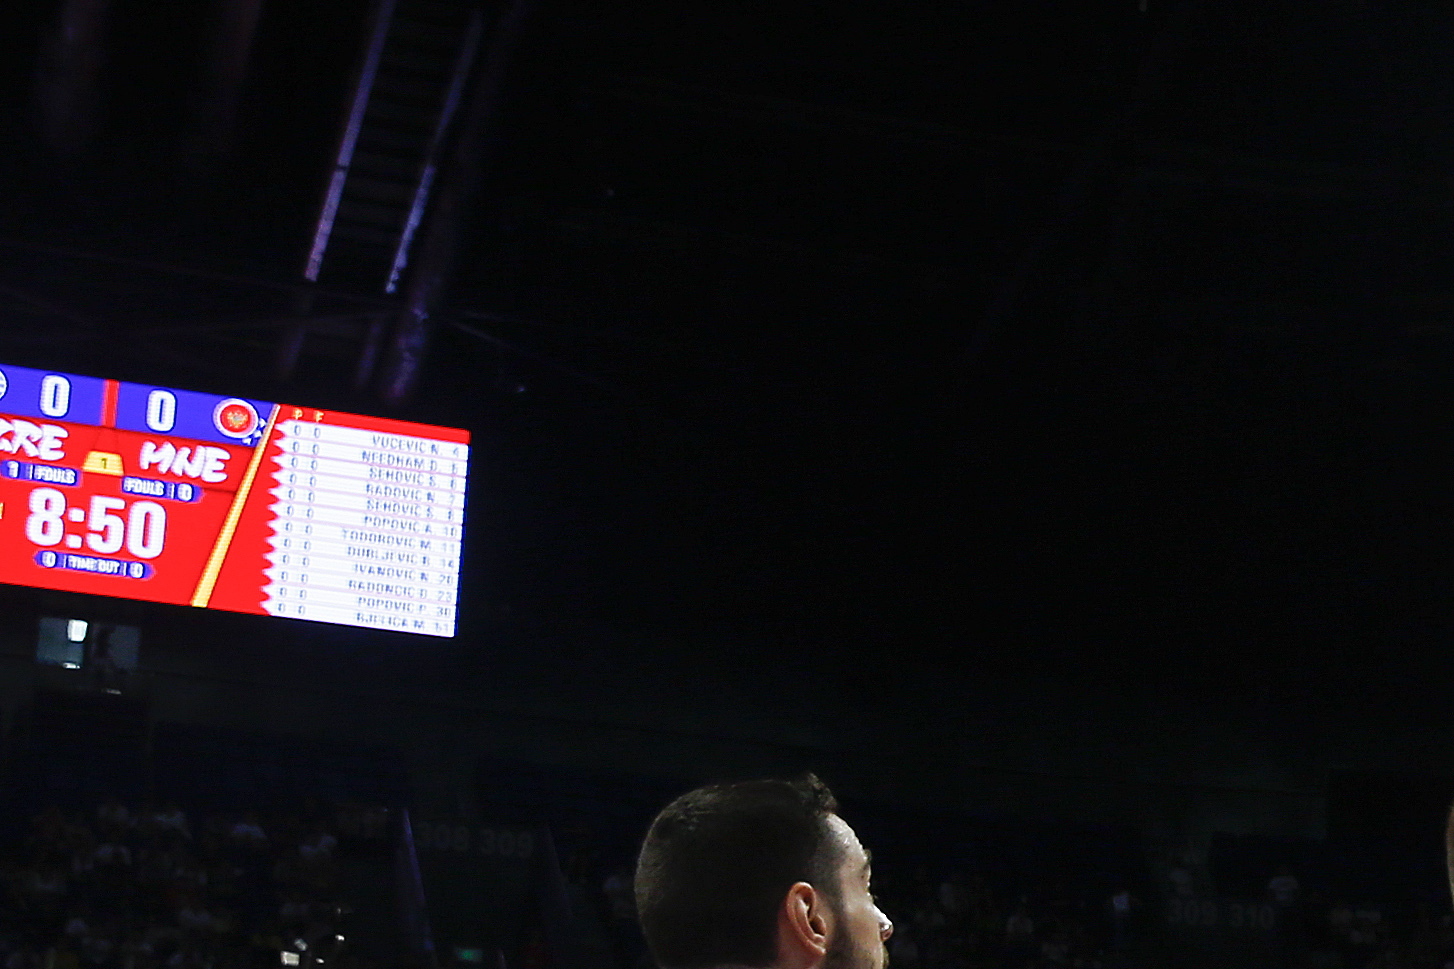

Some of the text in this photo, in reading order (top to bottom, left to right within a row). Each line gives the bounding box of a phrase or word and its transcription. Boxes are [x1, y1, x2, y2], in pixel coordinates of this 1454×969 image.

[40, 375, 70, 418] 0
[146, 390, 177, 432] 0
[372, 435, 427, 454] VUCEVIC
[139, 441, 231, 483] MNE
[361, 450, 424, 469] NEEDHAM
[7, 461, 19, 478] 1
[178, 483, 193, 501] 0
[25, 487, 167, 559] 8:50
[364, 516, 420, 533] POPOVIC
[42, 551, 56, 568] 0
[130, 562, 143, 579] 0
[358, 596, 415, 612] POPOVIC
